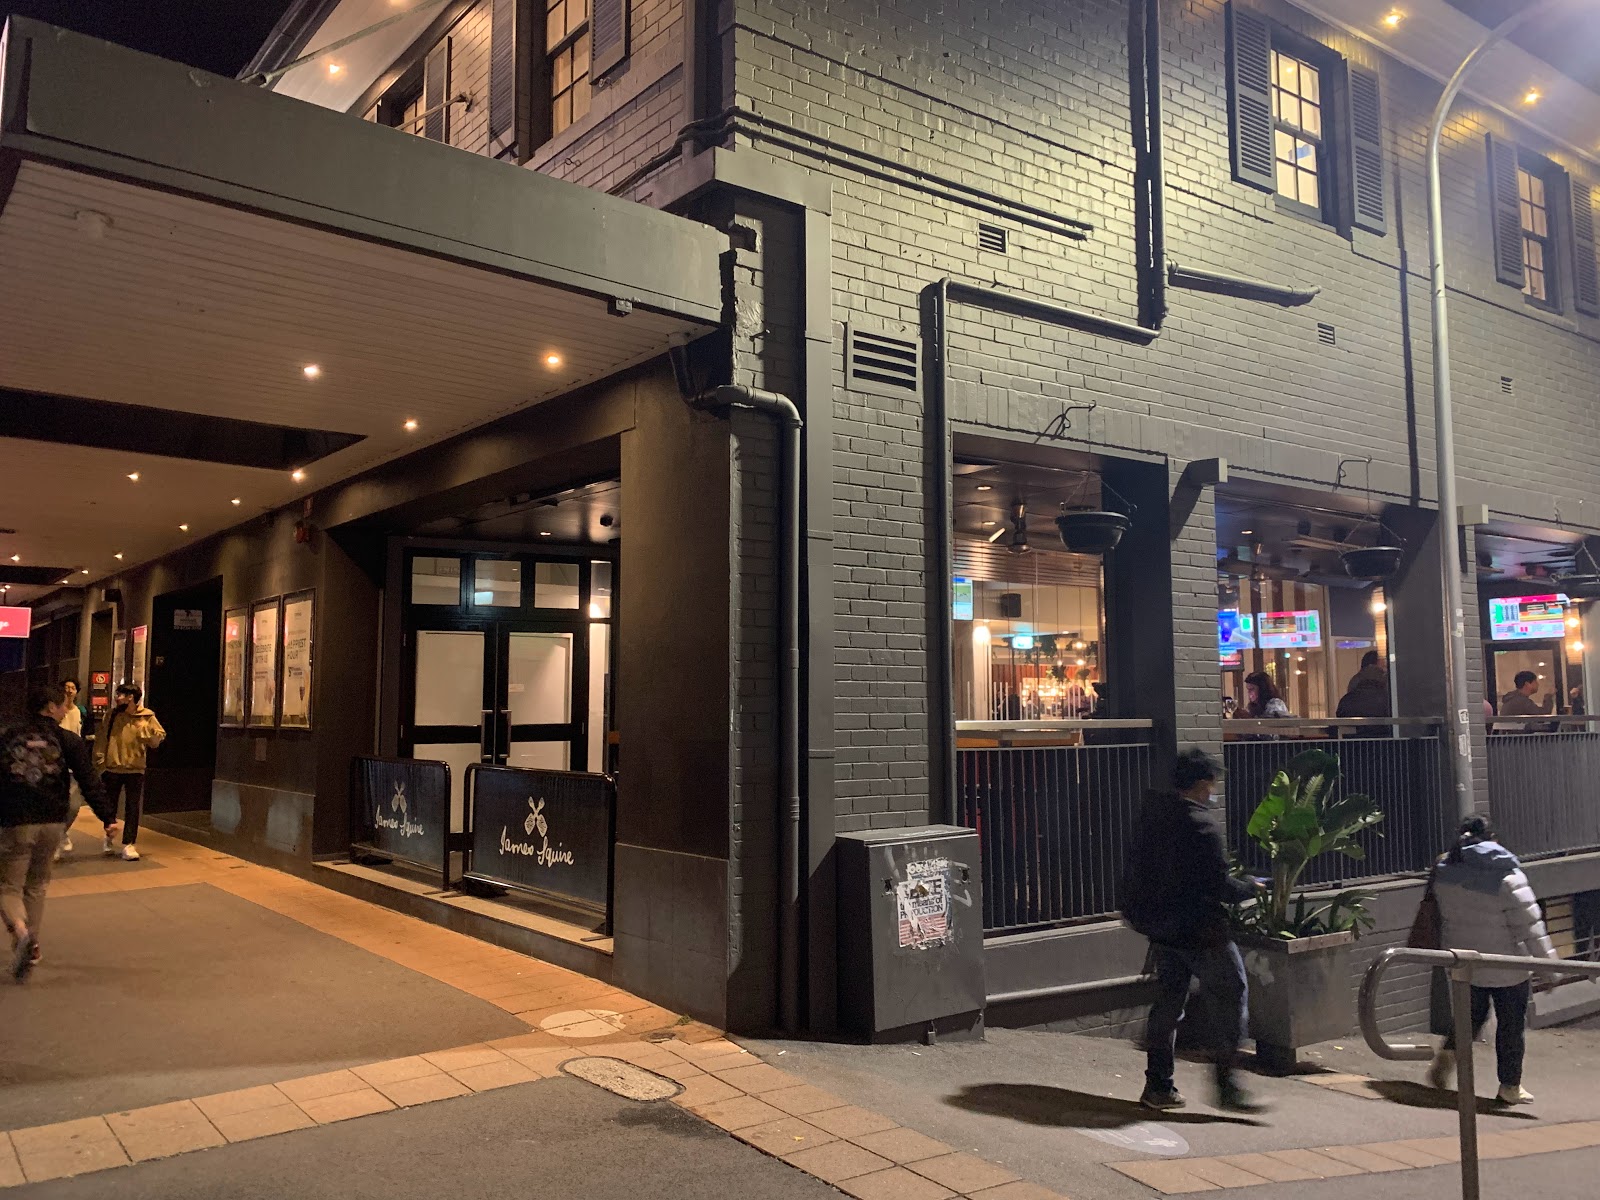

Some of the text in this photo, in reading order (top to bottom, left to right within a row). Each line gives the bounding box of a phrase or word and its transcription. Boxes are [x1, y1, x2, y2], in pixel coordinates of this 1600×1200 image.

[375, 805, 424, 837] James Squire
[499, 826, 574, 867] James Squire
